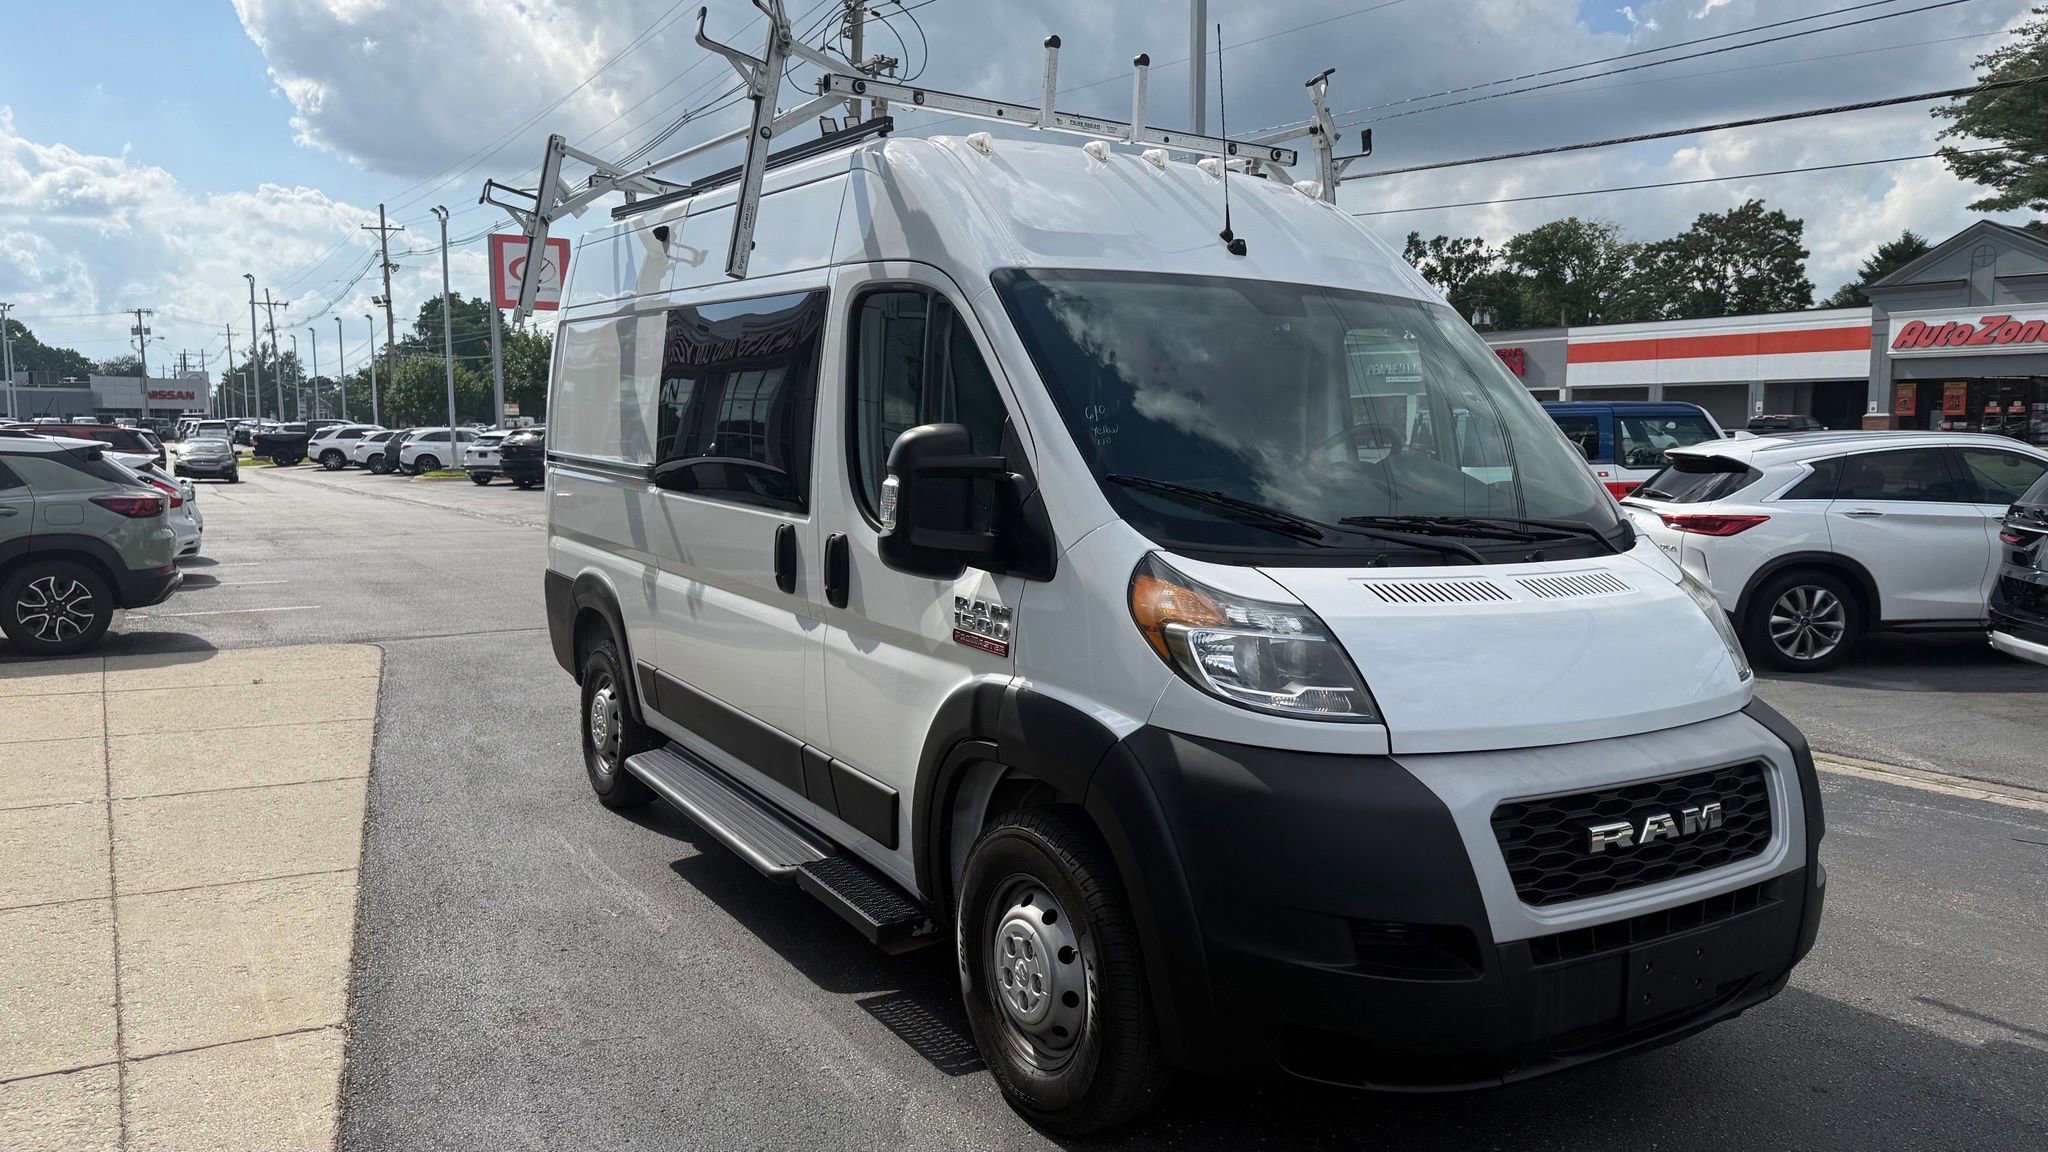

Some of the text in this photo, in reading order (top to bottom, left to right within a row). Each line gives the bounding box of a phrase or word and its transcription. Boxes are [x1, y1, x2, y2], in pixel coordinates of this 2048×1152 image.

[147, 390, 195, 400] NISSAN
[955, 595, 1013, 623] RAM
[954, 611, 1010, 640] 1500
[954, 630, 1006, 654] PROMASTER
[1589, 802, 1722, 854] RAM
